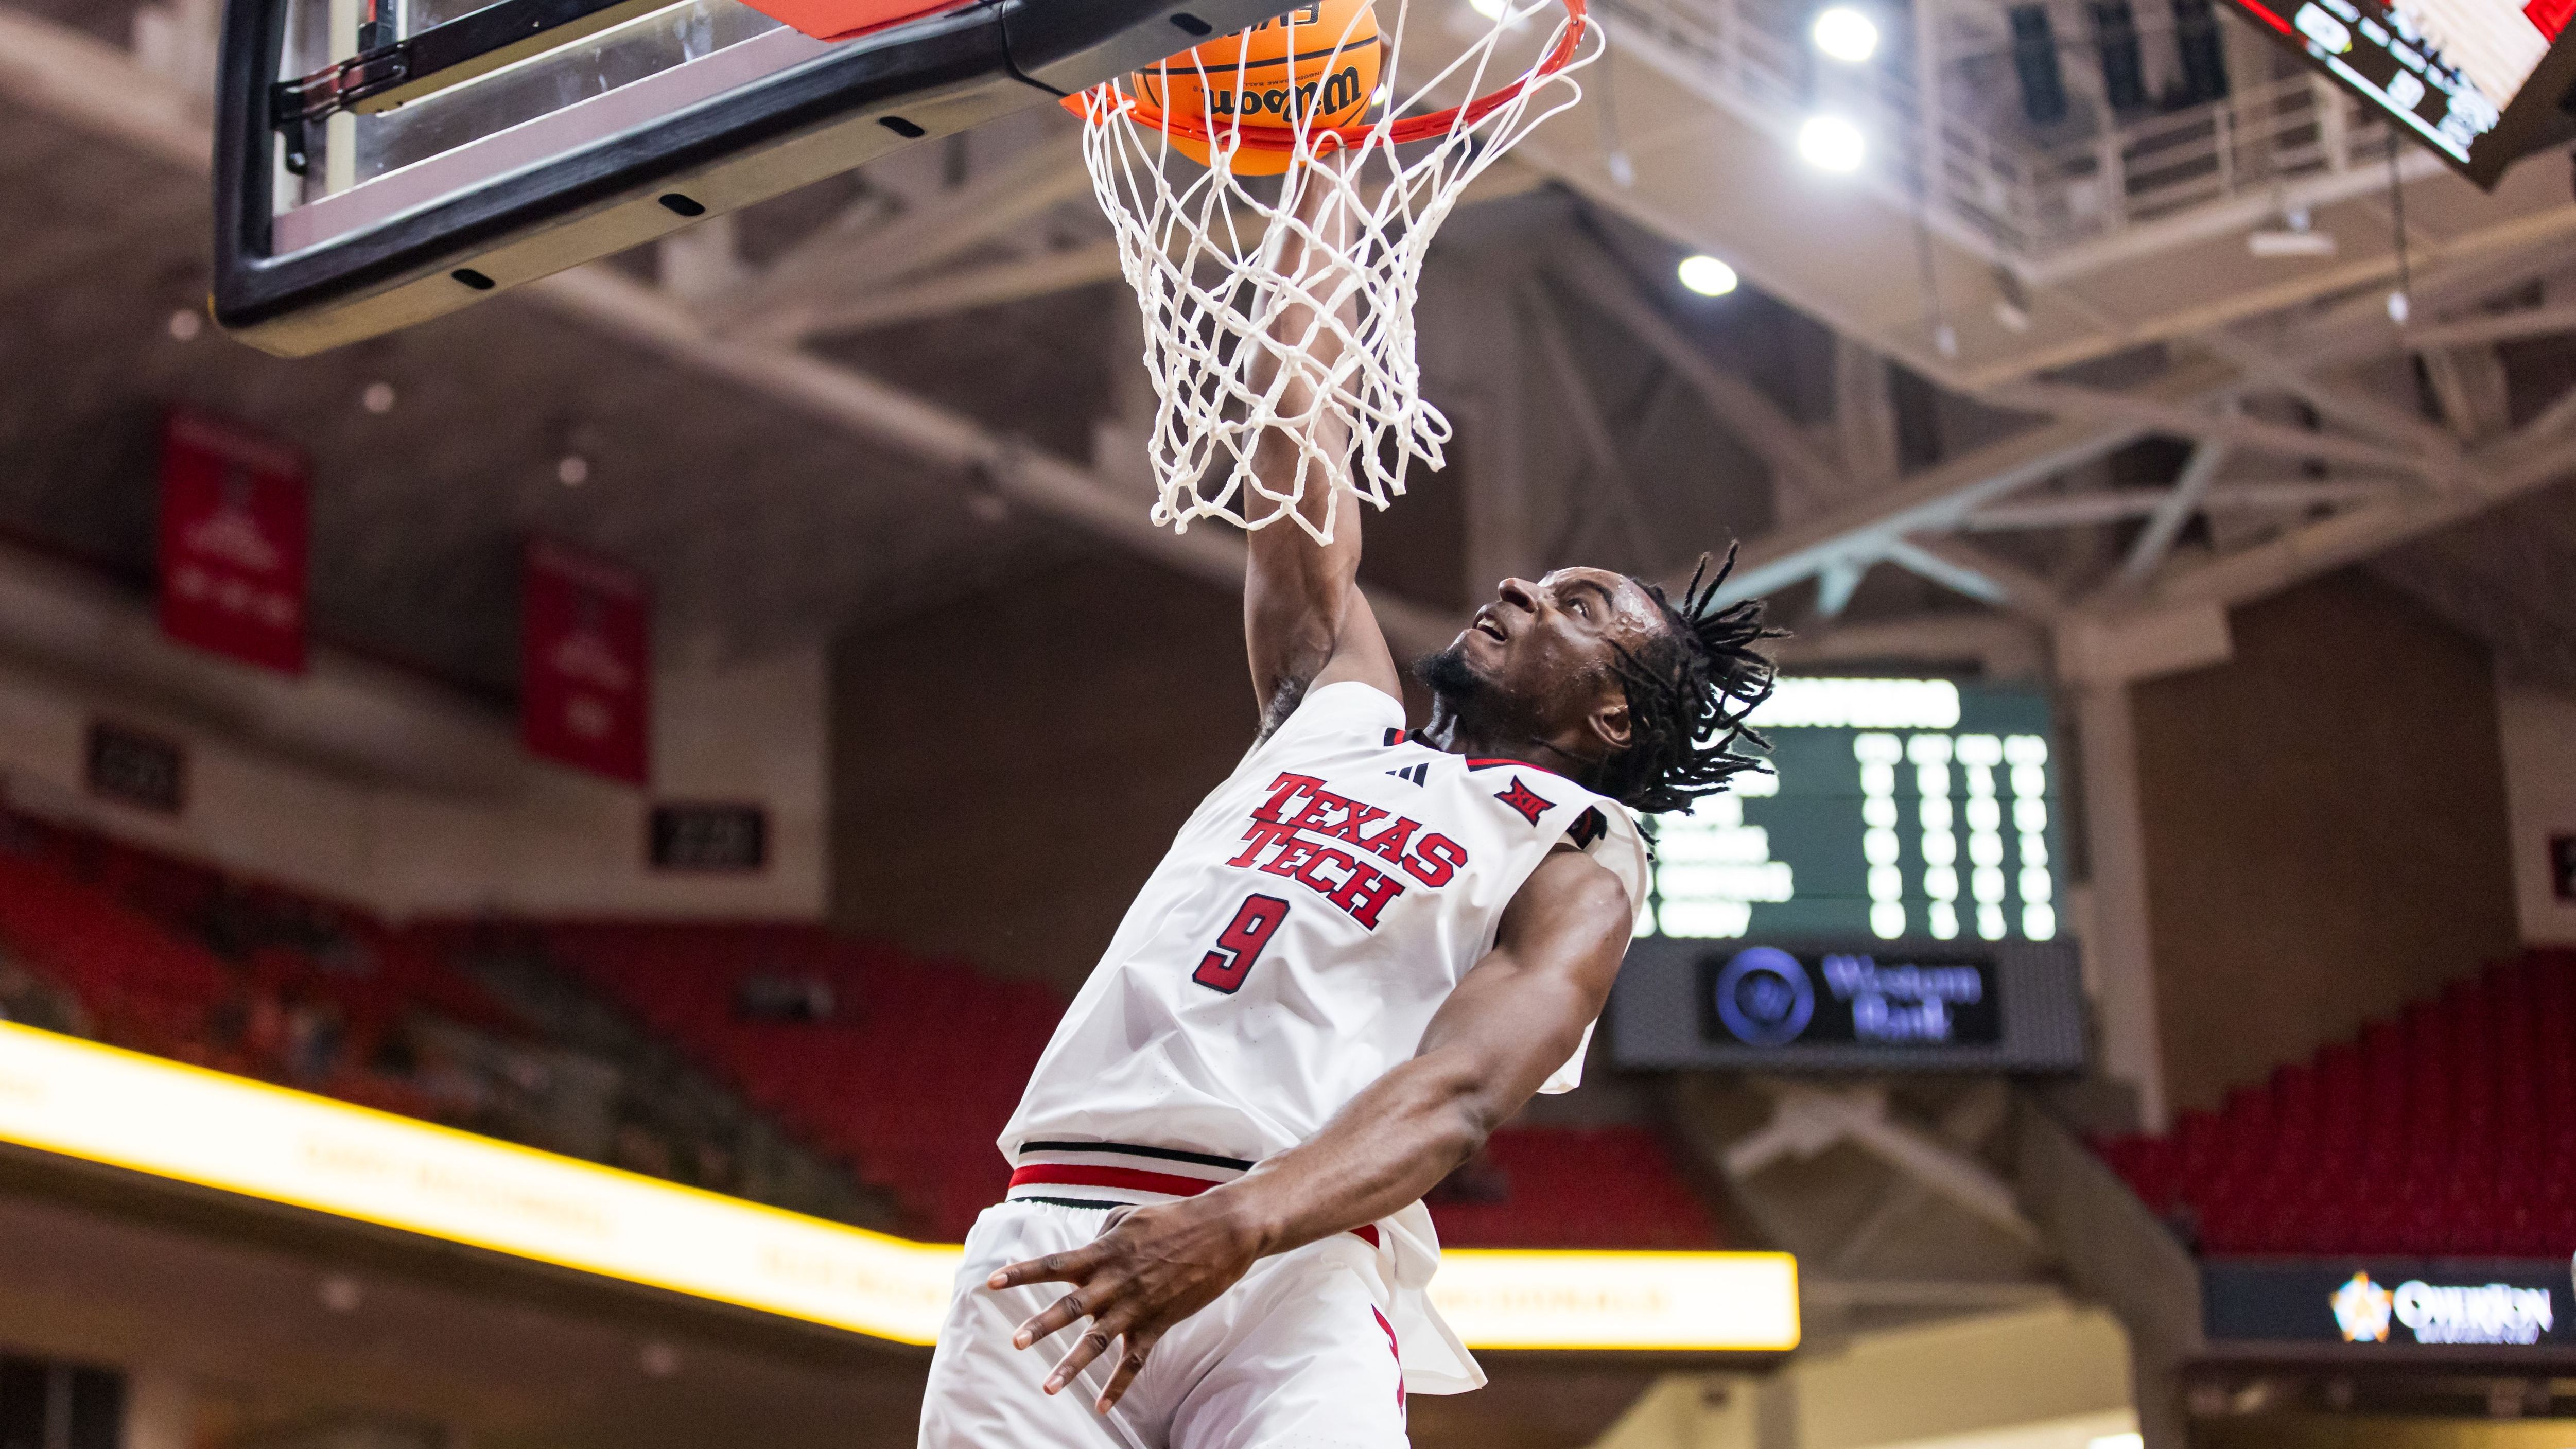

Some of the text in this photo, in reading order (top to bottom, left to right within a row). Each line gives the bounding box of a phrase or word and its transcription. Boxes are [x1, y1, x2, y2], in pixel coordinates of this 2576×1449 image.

[1201, 65, 1362, 123] Wilson
[1227, 818, 1406, 931] TECH
[1250, 771, 1468, 888] TEXAS
[1192, 893, 1291, 994] 9
